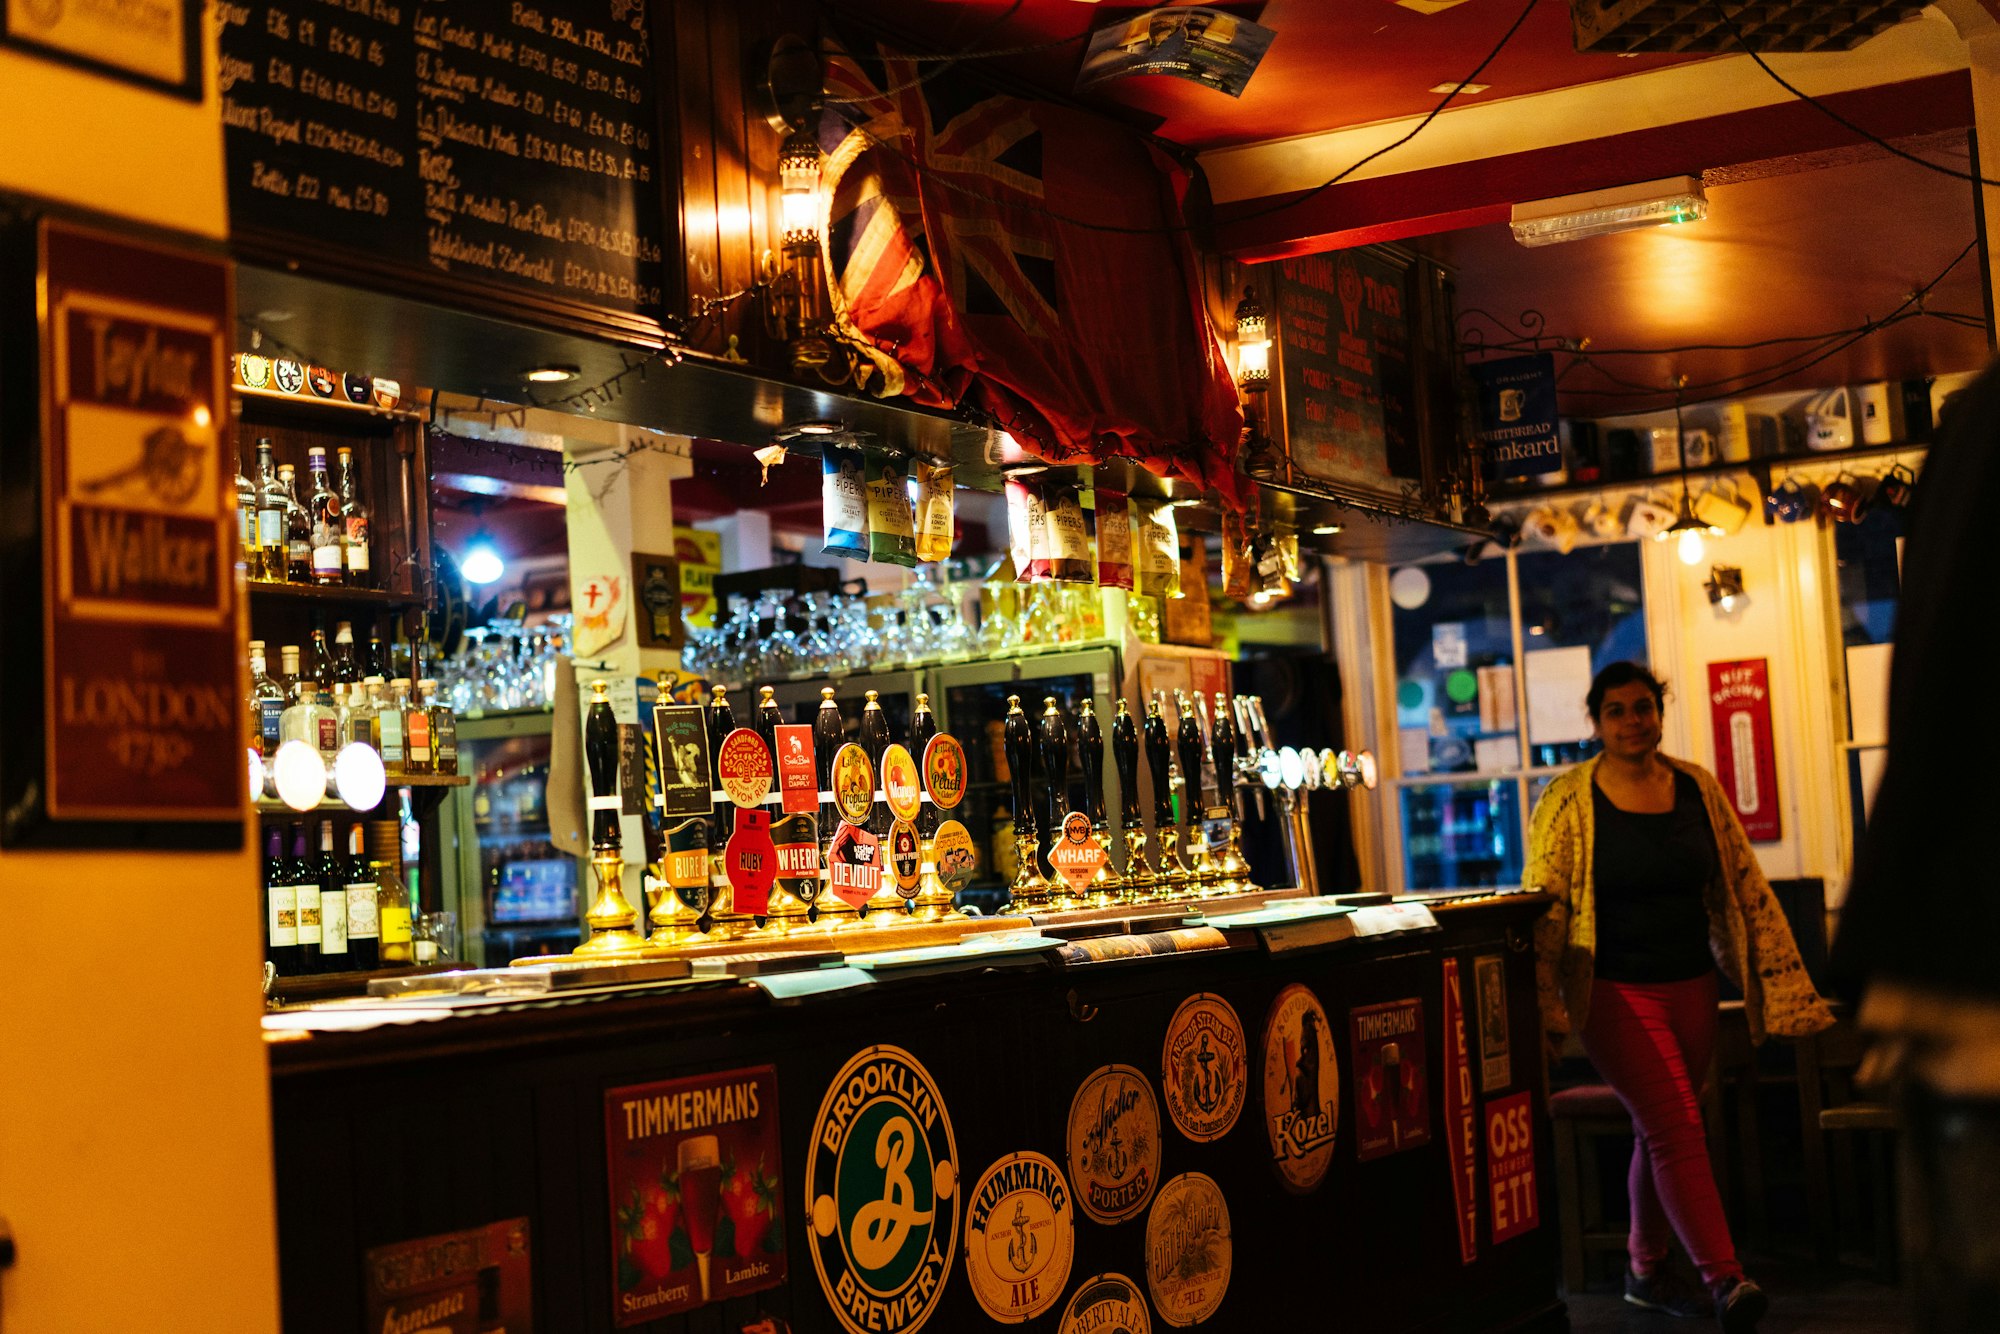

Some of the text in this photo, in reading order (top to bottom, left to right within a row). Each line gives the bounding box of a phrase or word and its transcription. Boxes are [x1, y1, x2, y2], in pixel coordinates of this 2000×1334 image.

[80, 509, 211, 594] Walker
[62, 674, 231, 730] LONDON
[1712, 684, 1765, 706] BROWN
[730, 734, 759, 749] SANDFORD
[727, 779, 767, 802] DEVON RED
[889, 781, 916, 804] Mango
[932, 773, 960, 792] Peach
[841, 790, 871, 805] Tropical
[675, 856, 699, 879] BURE
[739, 852, 763, 871] RUBY
[1056, 849, 1101, 863] WHARF
[833, 862, 879, 890] DEVOUT
[1357, 1008, 1416, 1042] TIMMERMANS
[1172, 1013, 1240, 1067] ANCHOR STEAM BEER
[623, 1081, 759, 1140] TIMMERMANS
[822, 1063, 937, 1155] BROOKLYN
[1081, 1077, 1140, 1172] Anchor
[1272, 1100, 1335, 1161] Kozel
[1490, 1104, 1531, 1158] OSS
[972, 1162, 1066, 1234] HUMMING
[1092, 1176, 1146, 1209] PORTER
[1493, 1171, 1533, 1231] ETT
[990, 1219, 1052, 1242] ANCHOR BREWING
[725, 1262, 769, 1284] Lambic
[836, 1237, 945, 1331] BREWERY
[622, 1284, 690, 1313] Strawberry
[1010, 1277, 1040, 1307] ALE
[1116, 1302, 1143, 1330] ALE
